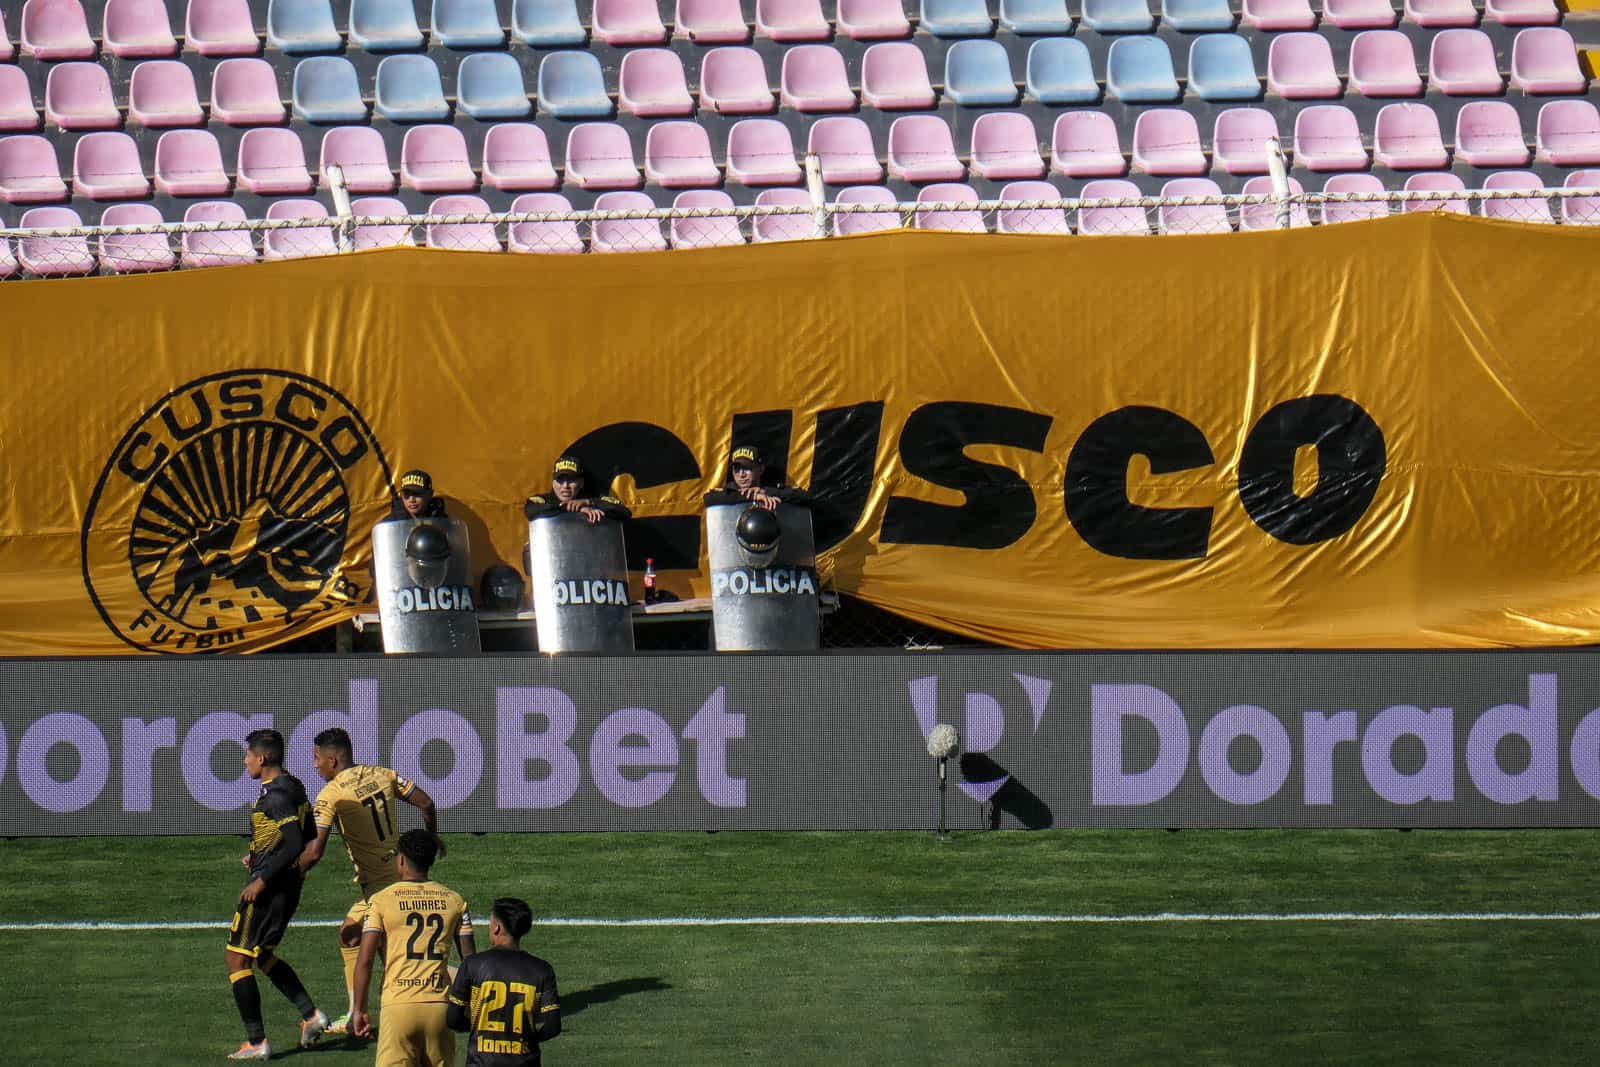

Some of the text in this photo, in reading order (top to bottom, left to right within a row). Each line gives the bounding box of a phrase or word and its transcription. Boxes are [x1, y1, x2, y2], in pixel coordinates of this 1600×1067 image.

[118, 378, 369, 484] CUSCO
[389, 587, 474, 613] OLICIA
[546, 580, 629, 606] OLICIA
[711, 569, 815, 599] POLICIA
[0, 678, 747, 812] oradoBet
[399, 899, 448, 911] OLIVARES
[406, 912, 444, 960] 22
[478, 981, 537, 1034] 27
